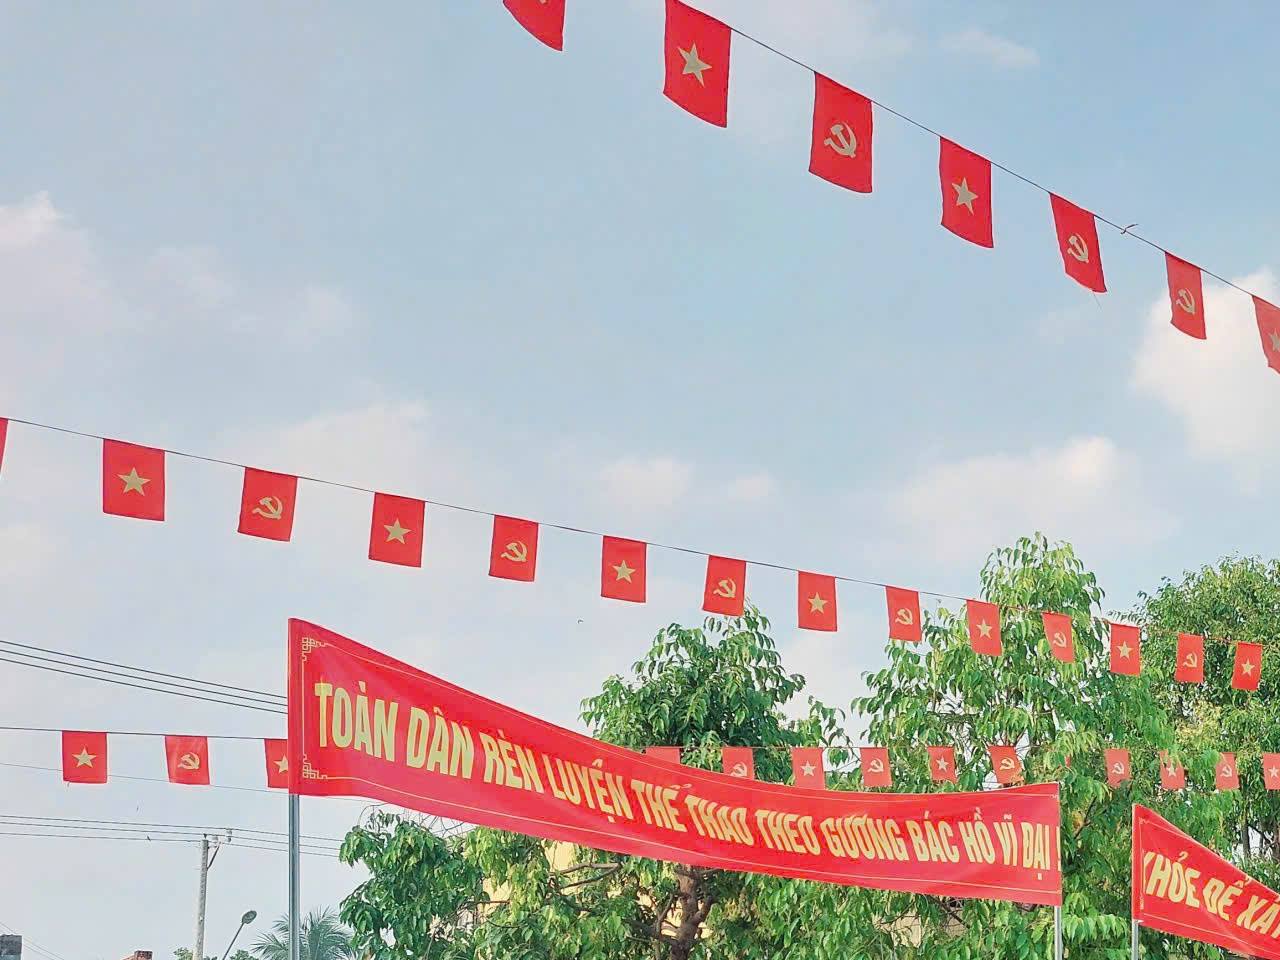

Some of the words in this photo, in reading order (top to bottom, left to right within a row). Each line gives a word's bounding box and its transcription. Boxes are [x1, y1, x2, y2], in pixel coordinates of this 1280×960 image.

[314, 681, 398, 762] TOÀN
[406, 706, 475, 780] DÂN
[479, 730, 545, 793] RÈN
[543, 753, 634, 823] LUYỆN
[684, 796, 754, 845] THAO
[754, 809, 821, 855] THEO
[820, 813, 908, 862] GƯƠNG
[905, 811, 959, 863] BÁC
[957, 807, 995, 864] HỒ
[994, 812, 1018, 867] VĨ
